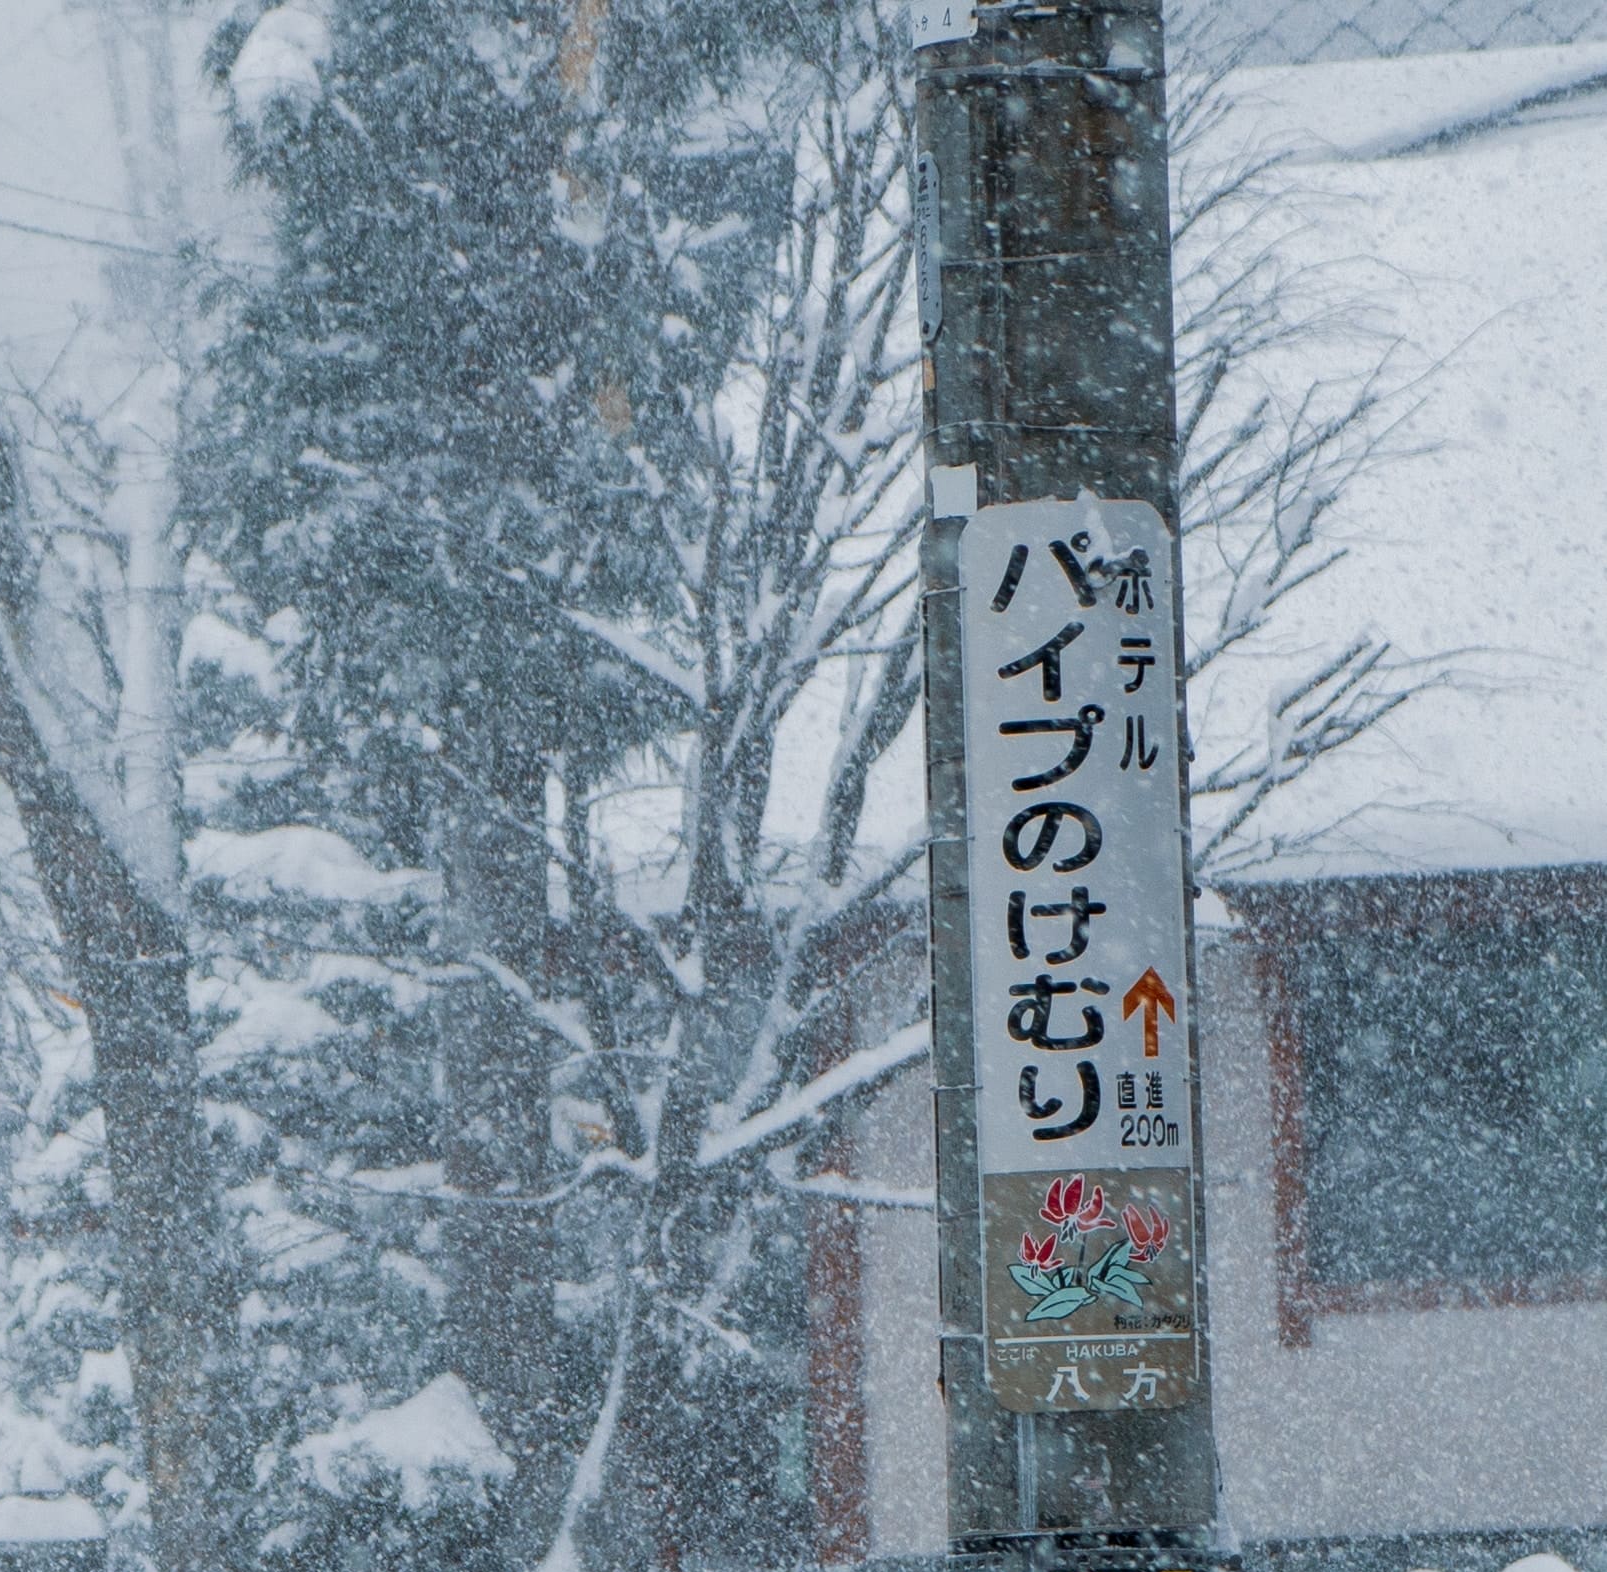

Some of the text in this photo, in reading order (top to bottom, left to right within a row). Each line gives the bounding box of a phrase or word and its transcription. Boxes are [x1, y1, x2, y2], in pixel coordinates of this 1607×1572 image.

[1115, 549, 1160, 771] ホテル
[989, 531, 1111, 1141] パイプのけむり
[1116, 1071, 1164, 1109] 直進
[1120, 1114, 1179, 1147] 200m
[996, 1347, 1036, 1361] ここは
[1066, 1344, 1138, 1358] HAKUBA
[1046, 1362, 1166, 1401] 八方
